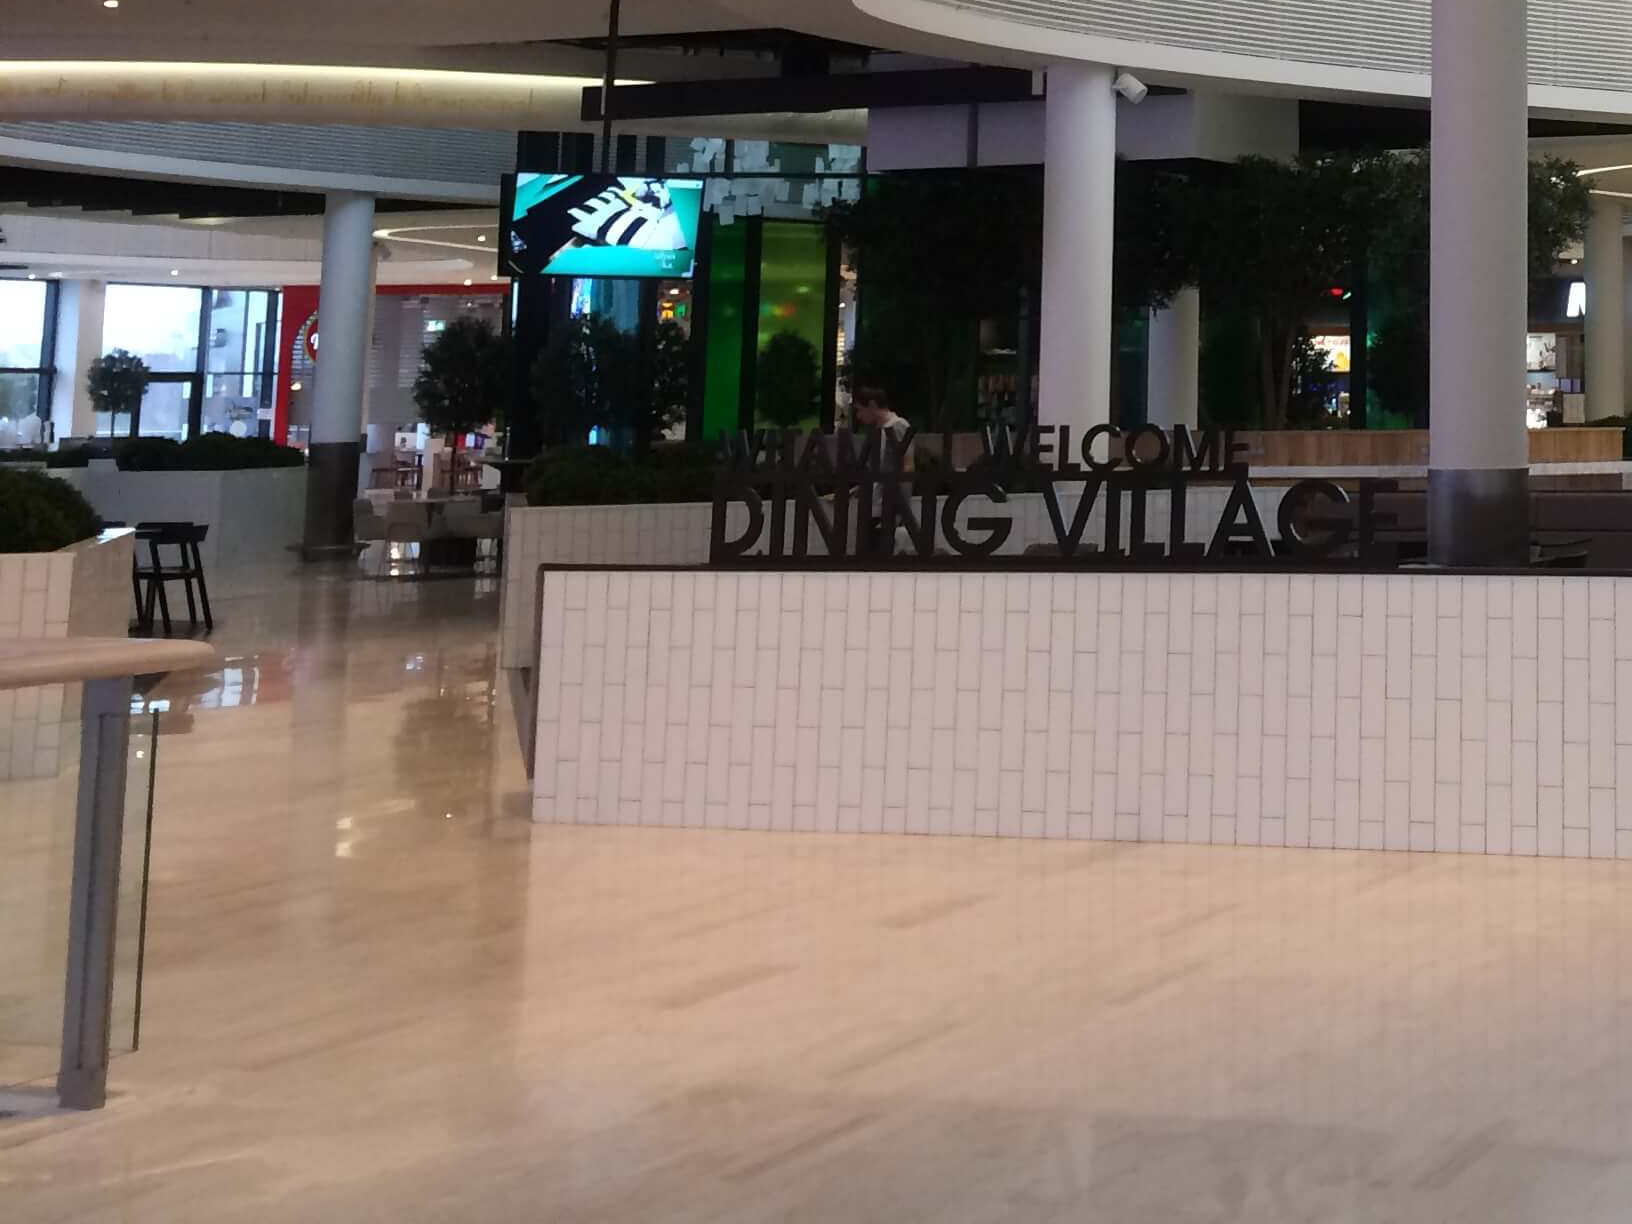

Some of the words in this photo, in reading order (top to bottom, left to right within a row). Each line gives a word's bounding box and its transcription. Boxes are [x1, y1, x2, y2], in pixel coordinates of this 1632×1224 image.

[982, 423, 1249, 473] WELCOME
[710, 478, 1012, 558] DINING
[1042, 478, 1399, 558] VILLAGE
